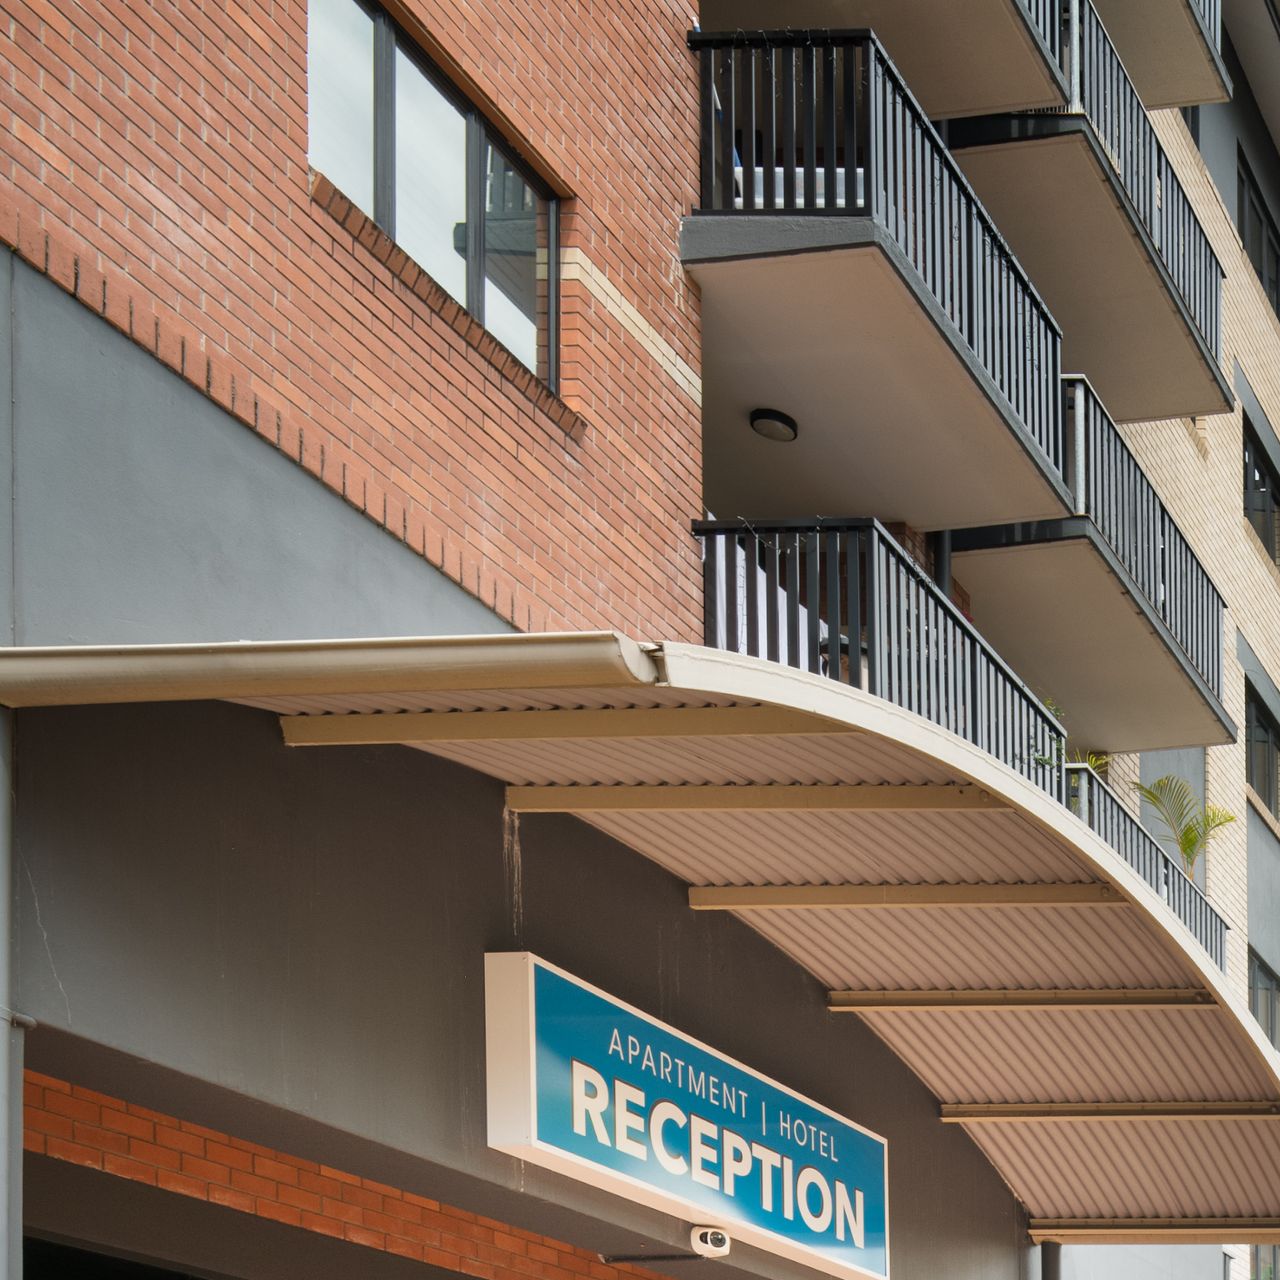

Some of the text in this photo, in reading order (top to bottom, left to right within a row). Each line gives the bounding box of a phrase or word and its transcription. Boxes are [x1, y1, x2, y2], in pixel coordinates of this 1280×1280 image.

[570, 1057, 865, 1249] RECEPTION
[608, 1028, 838, 1162] APARTMENT HOTEL
